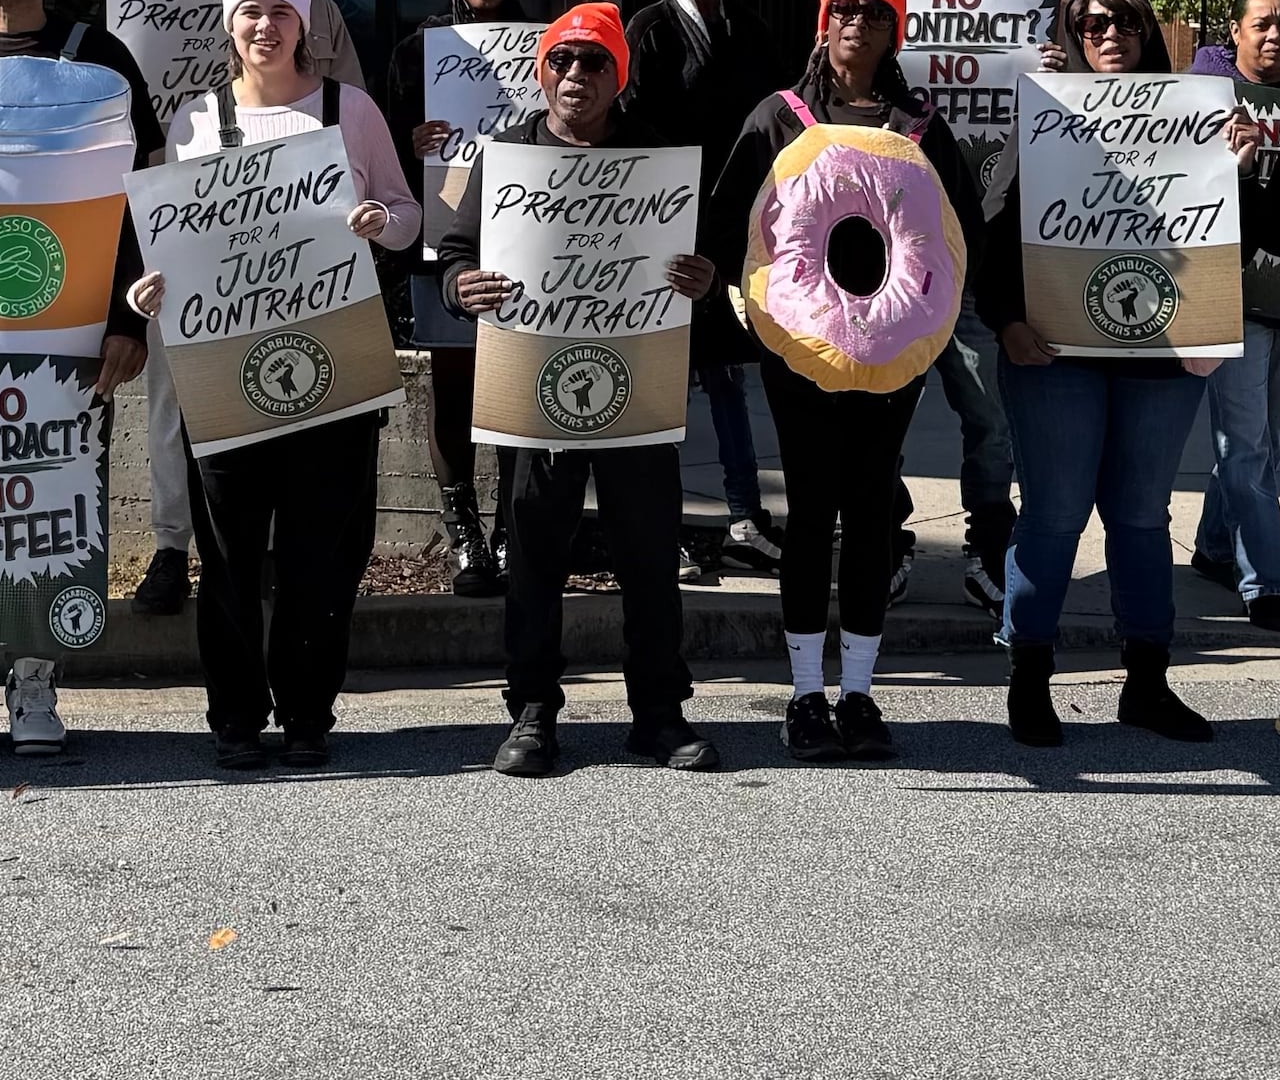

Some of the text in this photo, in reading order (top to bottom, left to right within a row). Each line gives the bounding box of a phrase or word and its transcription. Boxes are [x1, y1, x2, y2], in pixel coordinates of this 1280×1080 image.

[905, 9, 1041, 43] ONTRACT?
[182, 38, 215, 52] FOR
[163, 57, 228, 89] JUS
[434, 55, 537, 85] PRACTI
[929, 55, 979, 84] NO
[496, 87, 527, 100] FOR
[1084, 78, 1179, 112] JUST
[1030, 108, 1232, 145] PRACTICING
[195, 144, 286, 198] JUST
[548, 153, 650, 189] JUST
[1103, 150, 1157, 167] FOR A
[149, 163, 345, 246] PRACTICING
[492, 184, 693, 226] PRACTICING
[1082, 172, 1187, 209] JUST
[229, 221, 280, 250] FOR A
[1039, 197, 1225, 246] CONTRACT!
[34, 226, 61, 260] CAFE
[565, 233, 623, 250] FOR A
[216, 238, 315, 297] JUST
[541, 255, 651, 294] JUST
[1098, 259, 1166, 283] STARBUCKS
[0, 280, 60, 317] ESPRESSO
[180, 252, 356, 338] CONTRACT!
[495, 281, 675, 335] CONTRACT!
[1087, 296, 1172, 337] WORKERS UNITED
[249, 336, 317, 366] STARBUCKS
[553, 349, 621, 373] STARBUCKS
[247, 364, 329, 412] WORKERS UNITED
[542, 385, 626, 428] WORKERS UNITED
